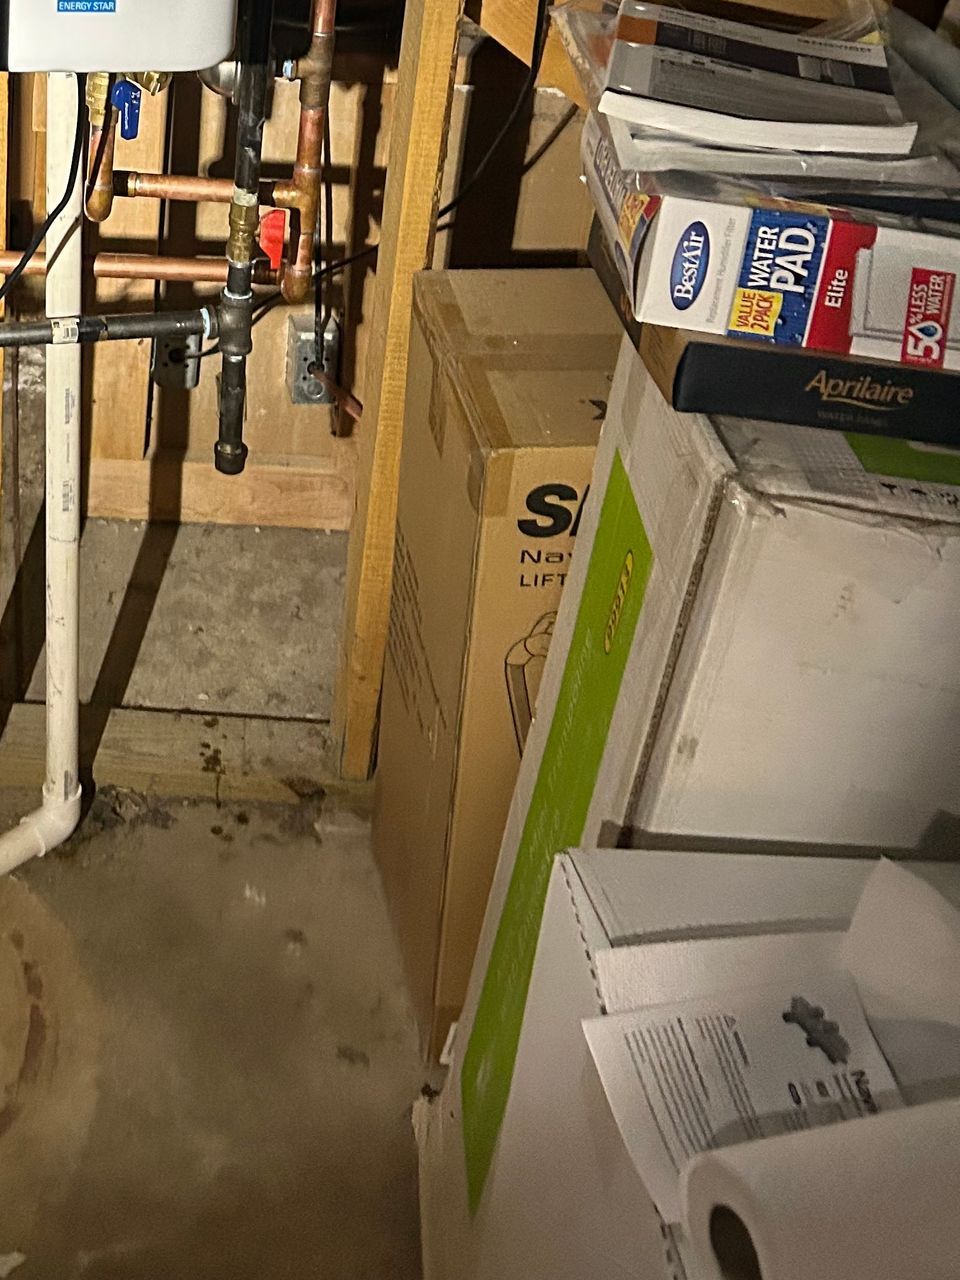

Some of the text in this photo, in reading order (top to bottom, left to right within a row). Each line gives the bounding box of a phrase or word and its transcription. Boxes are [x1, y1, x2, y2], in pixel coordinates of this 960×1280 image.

[59, 1, 115, 11] ENERGY STAR
[674, 231, 705, 301] BestAir
[747, 226, 780, 287] WATER
[770, 227, 816, 294] PAD
[824, 269, 849, 308] Elite
[910, 283, 928, 313] LESS
[925, 275, 945, 315] WATER
[736, 291, 756, 327] VALUE
[805, 370, 914, 404] Aprilaire
[517, 483, 590, 538] S
[520, 549, 572, 564] Na
